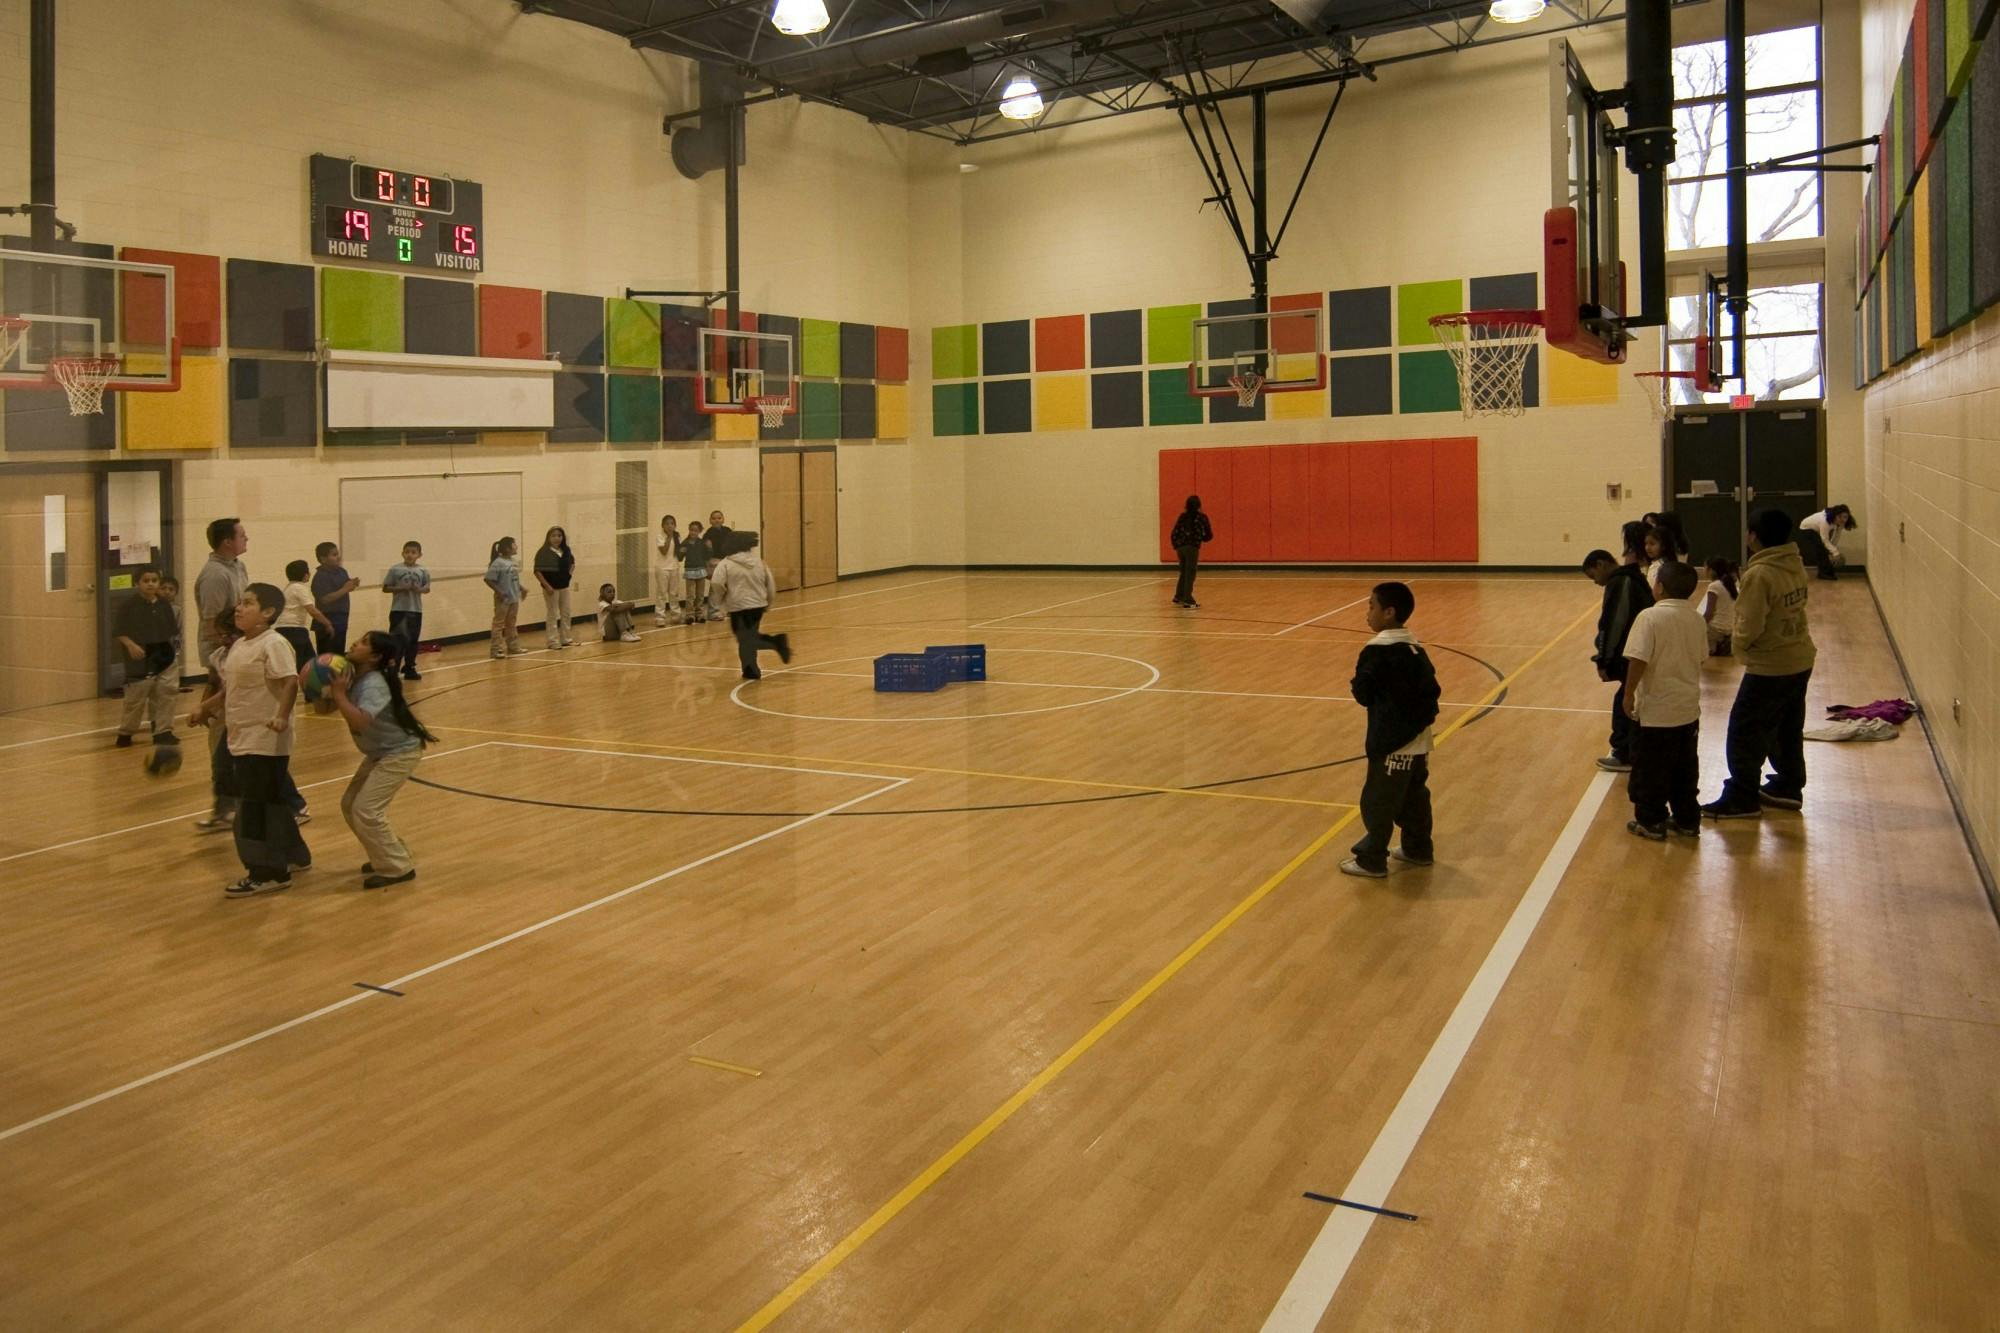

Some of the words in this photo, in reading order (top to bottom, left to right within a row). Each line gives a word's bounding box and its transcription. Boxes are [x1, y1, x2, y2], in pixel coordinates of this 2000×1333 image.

[392, 208, 416, 218] BONUS
[395, 217, 414, 227] POSS
[345, 210, 369, 241] 19
[387, 224, 422, 239] PERIOD
[328, 240, 368, 258] HOME
[454, 226, 475, 255] 15
[399, 238, 411, 262] 0
[435, 252, 481, 271] VISITOR
